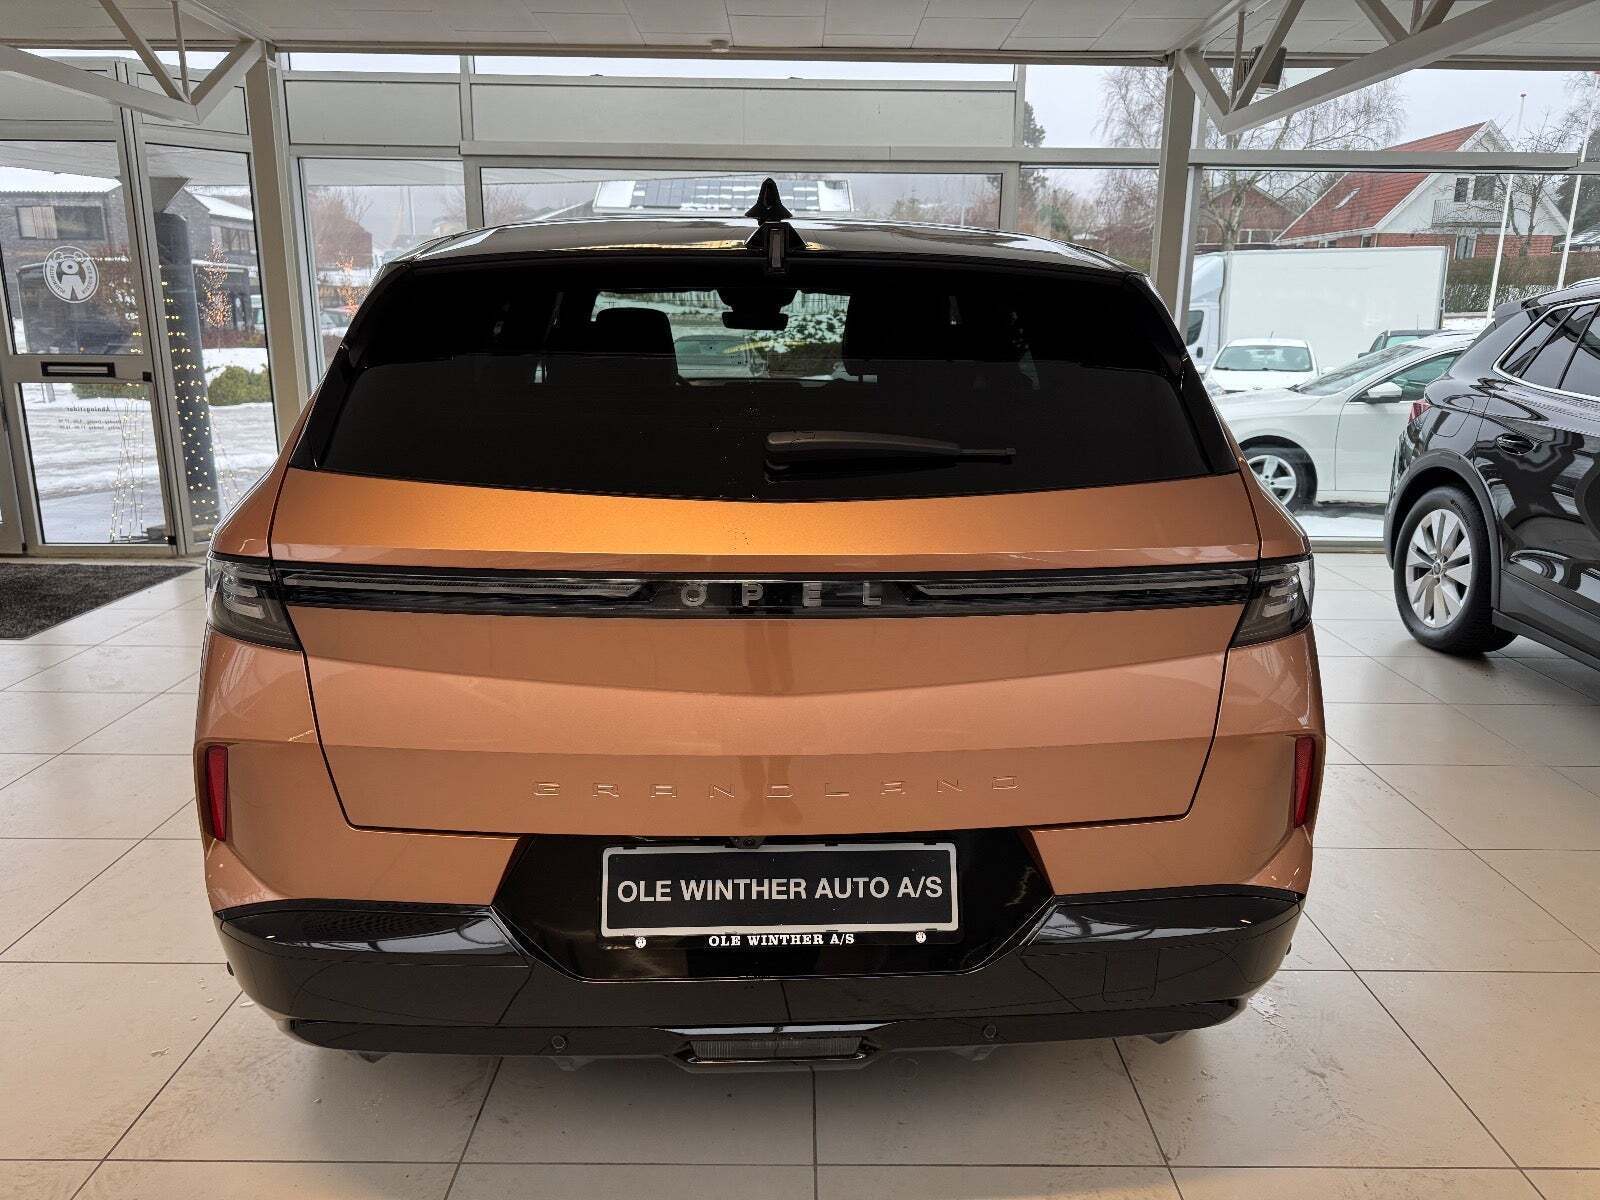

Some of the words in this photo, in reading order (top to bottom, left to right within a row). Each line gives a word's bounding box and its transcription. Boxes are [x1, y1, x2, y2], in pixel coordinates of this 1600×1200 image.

[680, 580, 882, 607] OPEL
[534, 776, 1020, 798] GRANDLAND
[617, 880, 672, 903] OLE
[680, 878, 807, 902] WINTHER
[814, 876, 890, 900] AUTO
[897, 875, 943, 899] A/S
[708, 935, 741, 947] OLE
[747, 933, 825, 946] WINTHER
[829, 933, 855, 945] A/S
